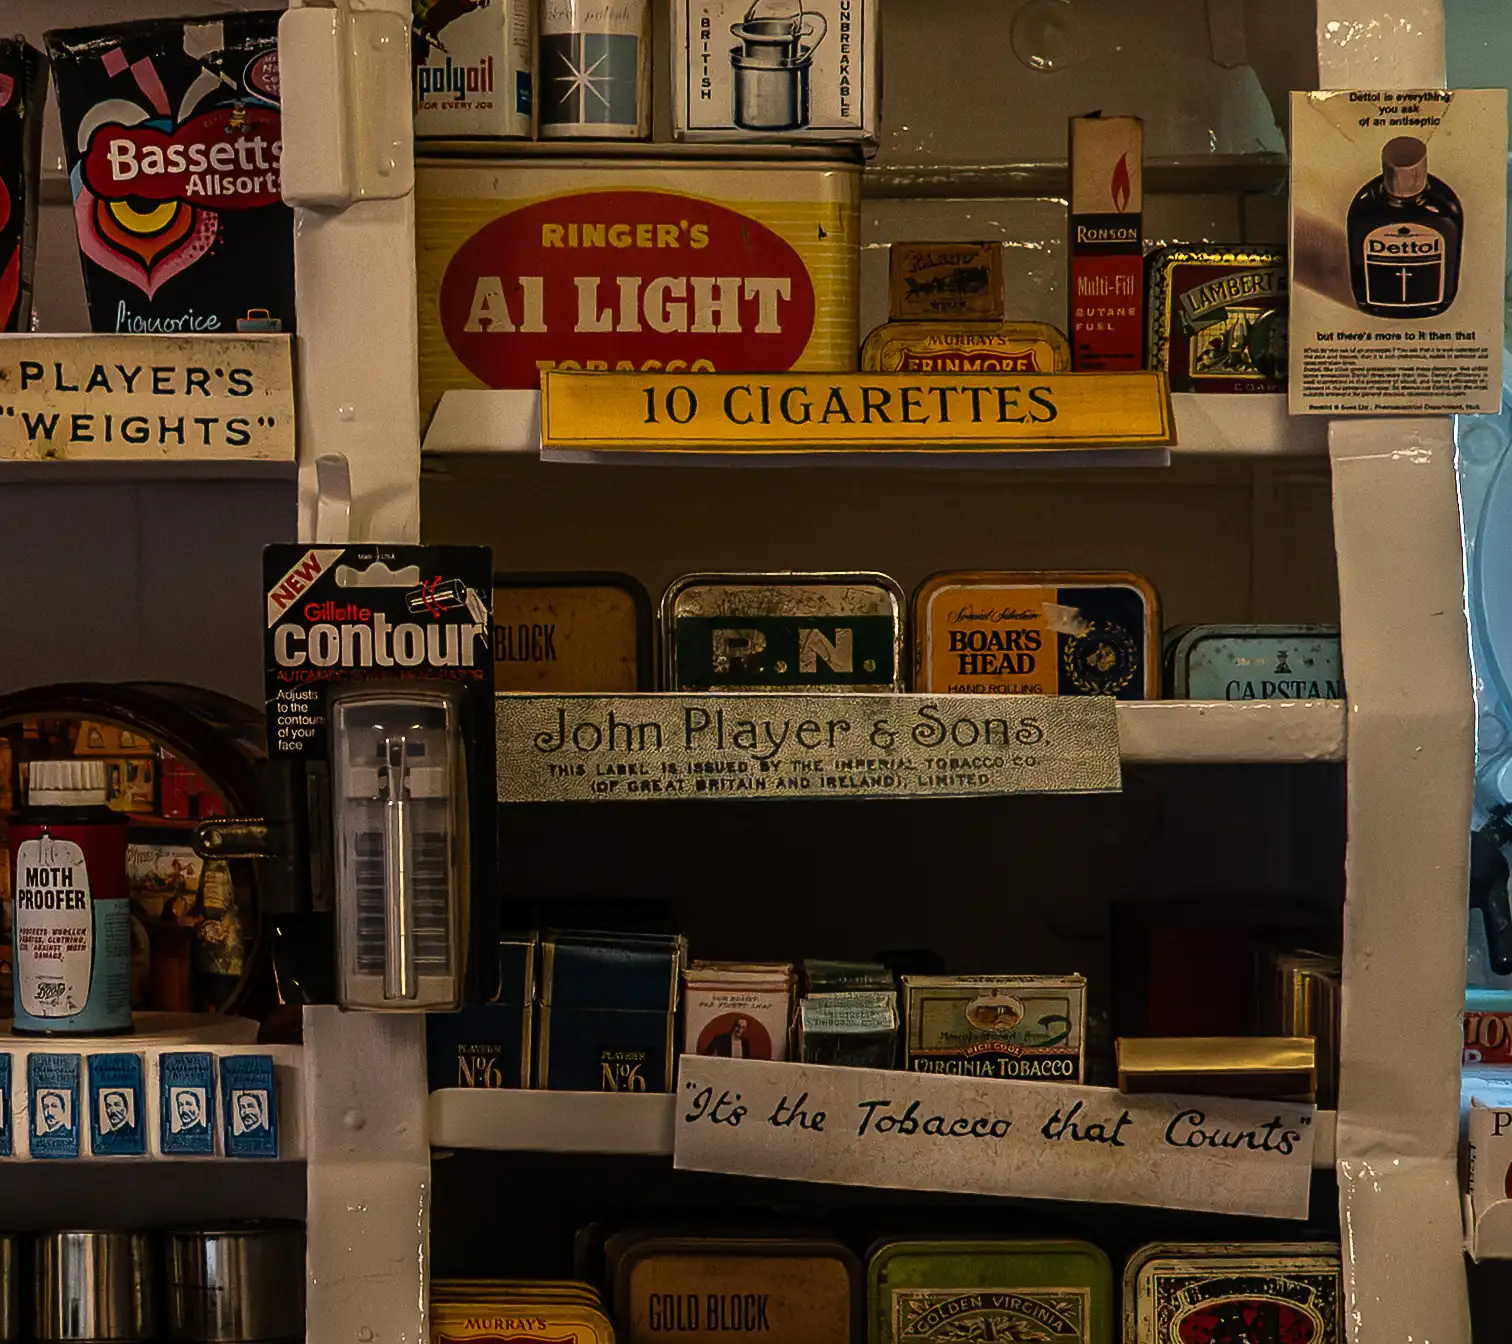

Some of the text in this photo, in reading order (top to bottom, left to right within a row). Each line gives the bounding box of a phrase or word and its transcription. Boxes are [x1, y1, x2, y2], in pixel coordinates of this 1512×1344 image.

[700, 17, 712, 101] BRITISH
[839, 0, 852, 118] UNBREAKABLE
[1349, 92, 1380, 102] Dettol
[1396, 90, 1450, 103] everything
[1379, 105, 1419, 115] you ask
[1359, 117, 1440, 127] of an antiseptic
[541, 220, 710, 249] RINGER'S
[1076, 225, 1138, 243] RONSON
[1366, 239, 1440, 256] Dettol
[1076, 274, 1135, 298] Multi-Fill
[574, 276, 792, 334] LIGHT
[1076, 307, 1137, 319] BUTANE
[1076, 321, 1115, 332] FUEL
[1317, 332, 1333, 340] but
[1337, 332, 1372, 340] there's
[1419, 332, 1426, 340] it
[1429, 332, 1451, 340] than
[1455, 332, 1476, 340] that
[19, 360, 255, 398] PLAYER'S
[643, 385, 1060, 426] 10 CIGARETTES
[270, 552, 322, 608] NEW
[304, 602, 372, 622] Gillette
[274, 612, 482, 667] contour
[948, 628, 1041, 653] BOAR'S
[957, 651, 1035, 675] HEAD
[277, 690, 319, 700] Adjusts
[277, 702, 308, 712] to the
[278, 727, 315, 738] of your
[533, 702, 1051, 760] John Player & Sons.
[278, 739, 303, 750] face
[549, 756, 1041, 778] THIS LABEL IS ISSUED BY THE IMPERIAL TOBACCO CO.
[591, 779, 620, 795] (OF
[627, 779, 685, 794] GREAT
[695, 777, 767, 793] BRITAIN
[777, 776, 811, 791] AND
[25, 866, 74, 889] MOTH
[17, 888, 87, 911] PROOFER
[769, 1091, 826, 1133] the
[857, 1102, 1011, 1139] Tobacco
[1041, 1100, 1132, 1147] that
[1165, 1109, 1312, 1156] Counts"
